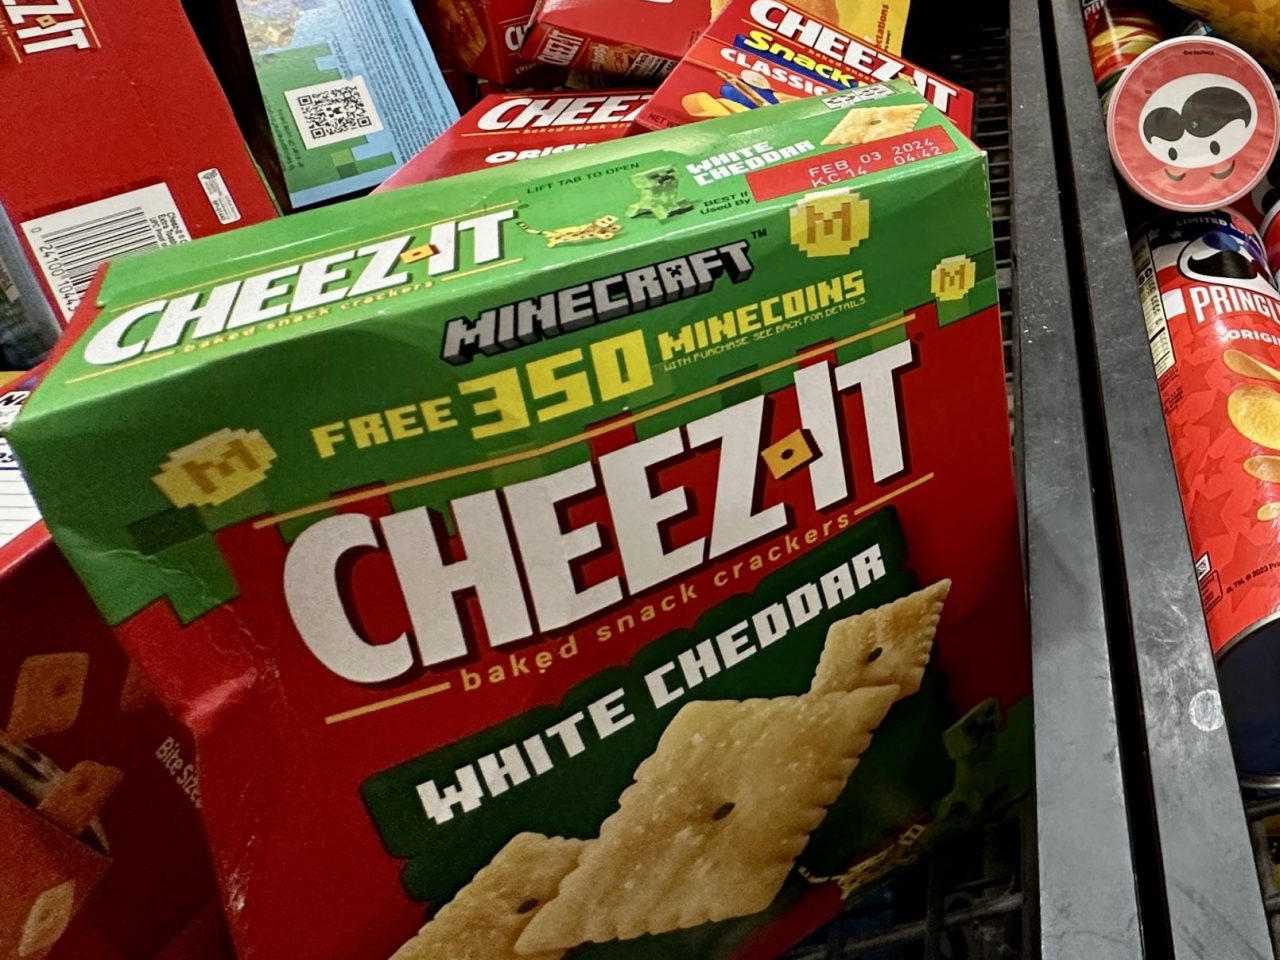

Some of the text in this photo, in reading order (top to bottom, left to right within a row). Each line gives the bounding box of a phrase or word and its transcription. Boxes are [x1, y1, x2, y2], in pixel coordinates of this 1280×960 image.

[686, 141, 773, 176] WHITE
[694, 139, 816, 187] CHEDDAR
[808, 137, 936, 180] FEB 03 2024
[893, 144, 944, 166] 04:42
[526, 161, 640, 195] LIFT TAB TO OPEN
[703, 195, 734, 209] BEST
[1176, 213, 1228, 227] LIMITED
[181, 278, 435, 355] baked snack crackers
[440, 239, 755, 363] MINECRAFT
[657, 269, 866, 361] MINECOINS
[775, 320, 802, 335] BACK
[310, 329, 655, 460] FREE 350
[461, 510, 852, 691] baked snack crackers
[416, 542, 888, 826] WHITE CHEDDAR
